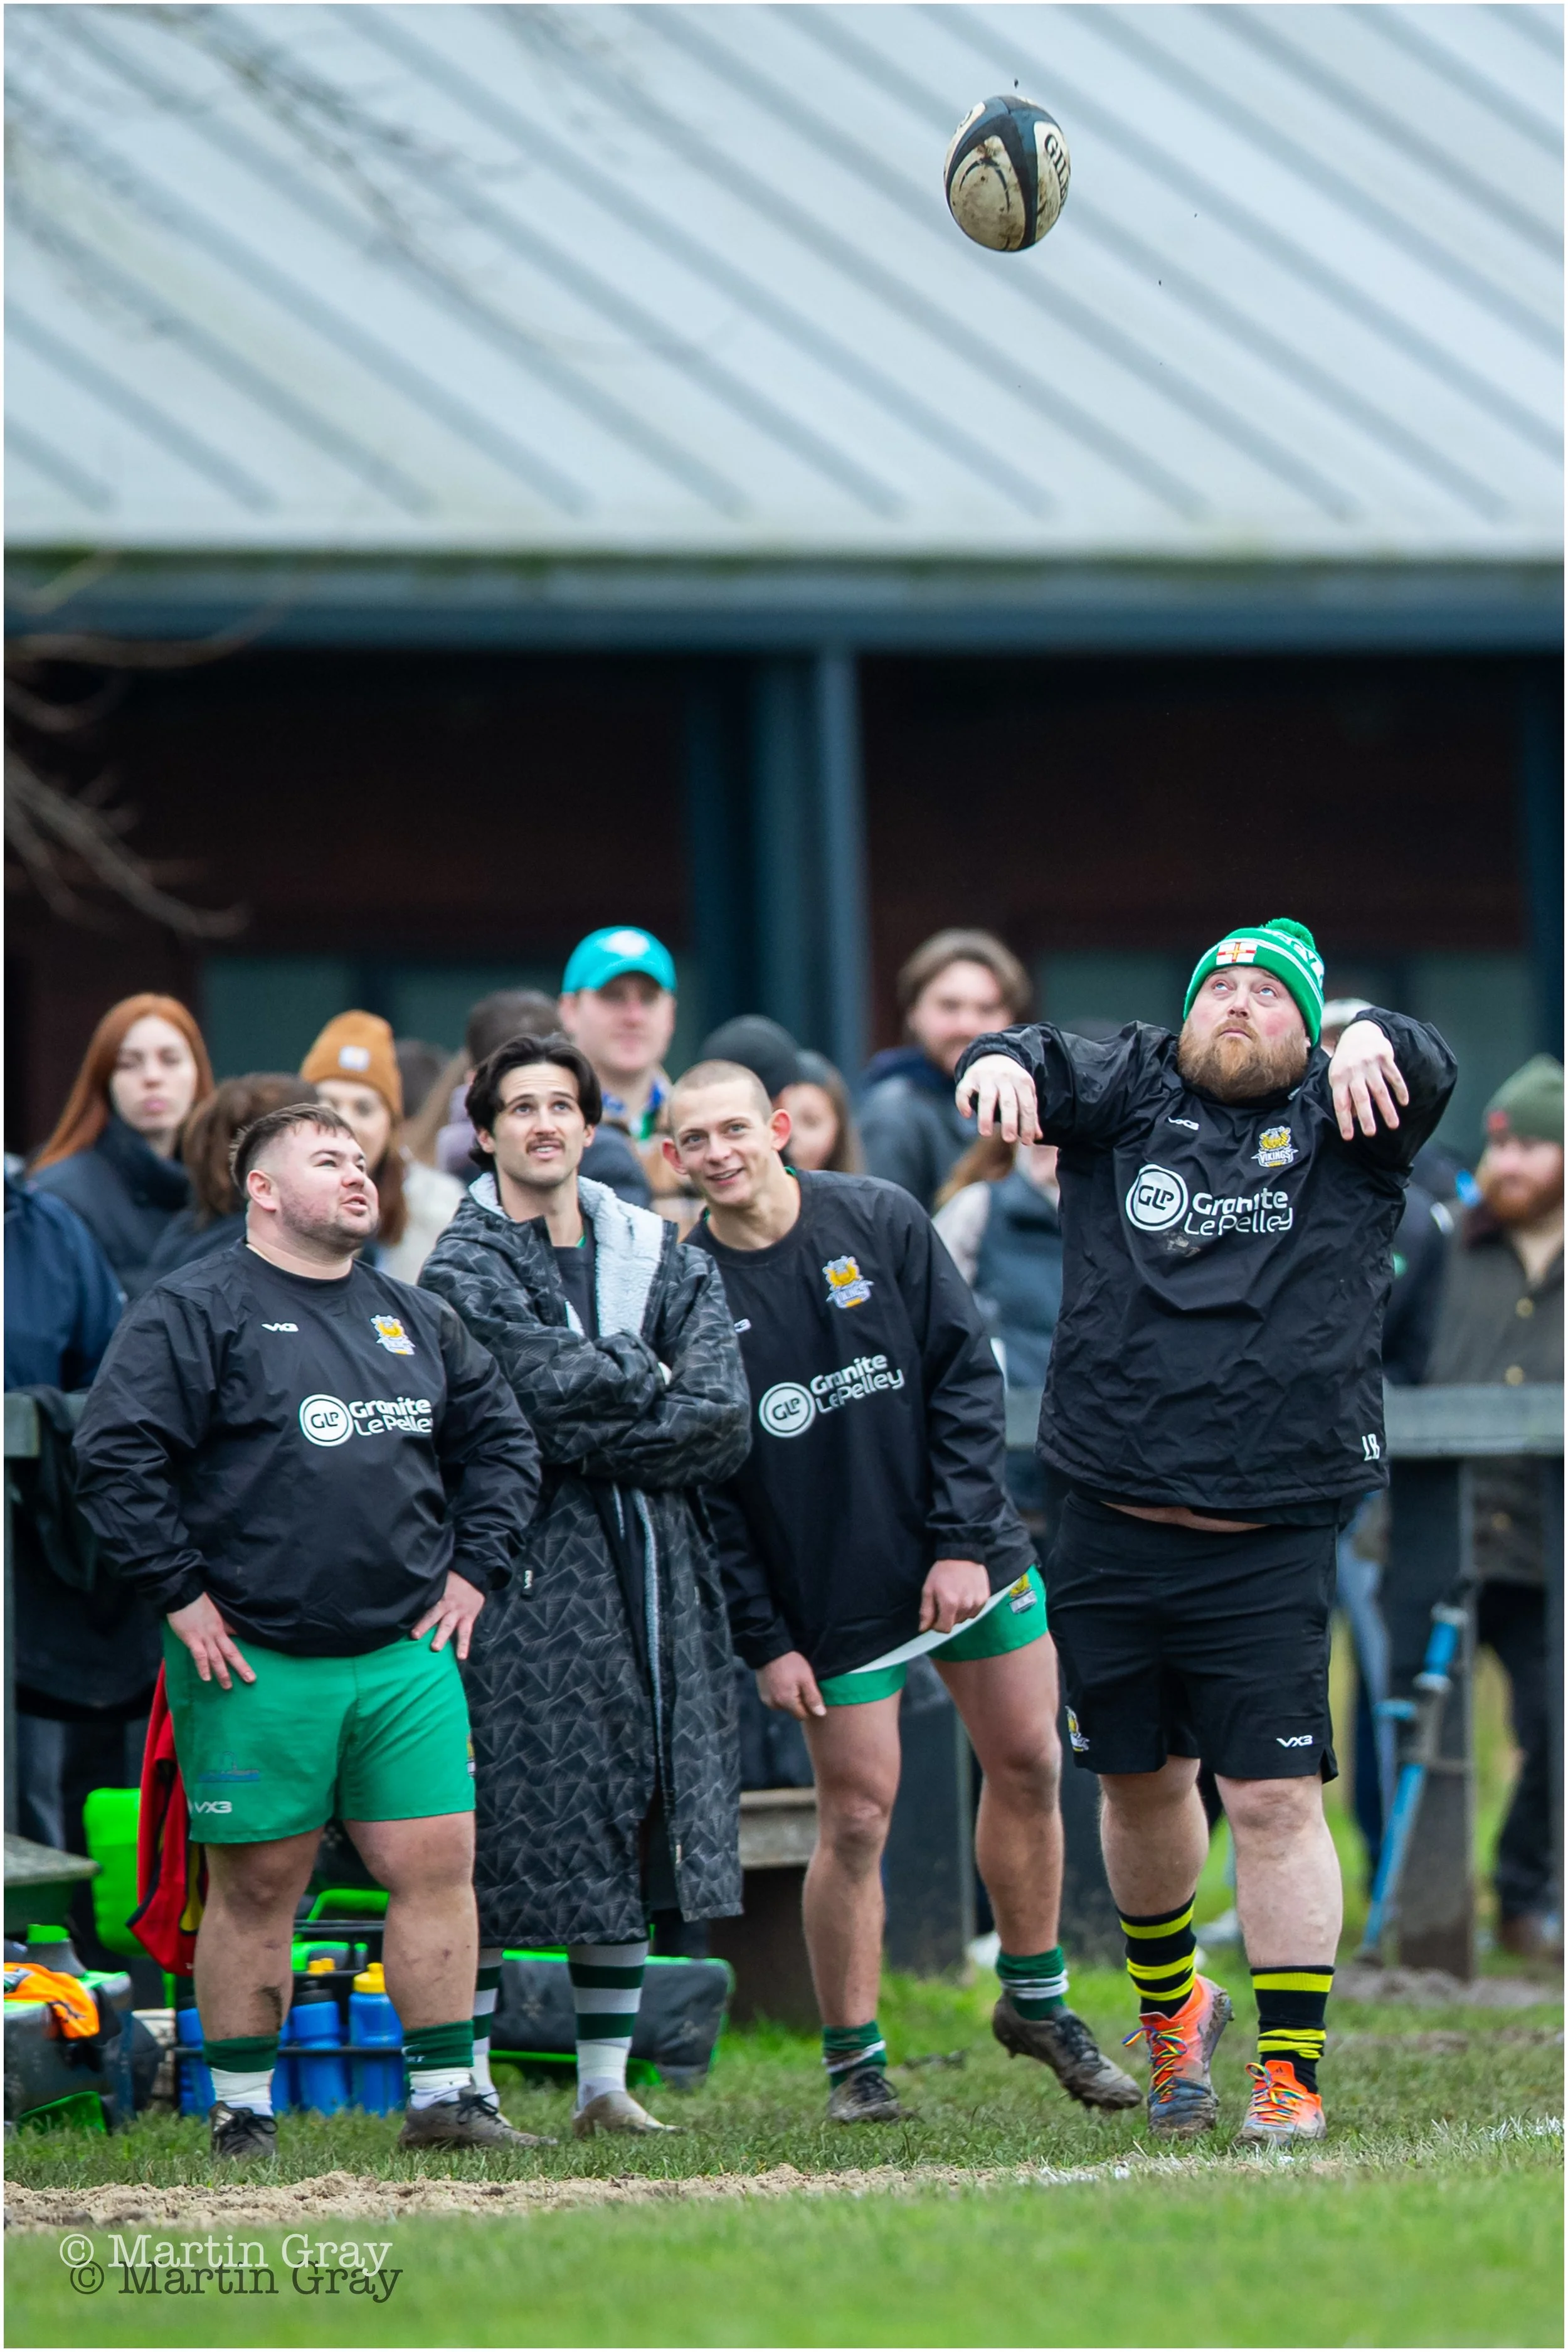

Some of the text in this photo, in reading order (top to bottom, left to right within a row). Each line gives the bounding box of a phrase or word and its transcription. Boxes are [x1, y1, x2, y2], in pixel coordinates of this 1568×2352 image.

[1138, 1184, 1175, 1211] GLP
[1192, 1188, 1289, 1216] Granite
[348, 1397, 432, 1419] Granite
[771, 1397, 800, 1420] GLP
[310, 1412, 339, 1429] GLP
[353, 1414, 434, 1437] LePelle
[1276, 1734, 1313, 1748] VX3
[194, 1801, 233, 1814] VX3
